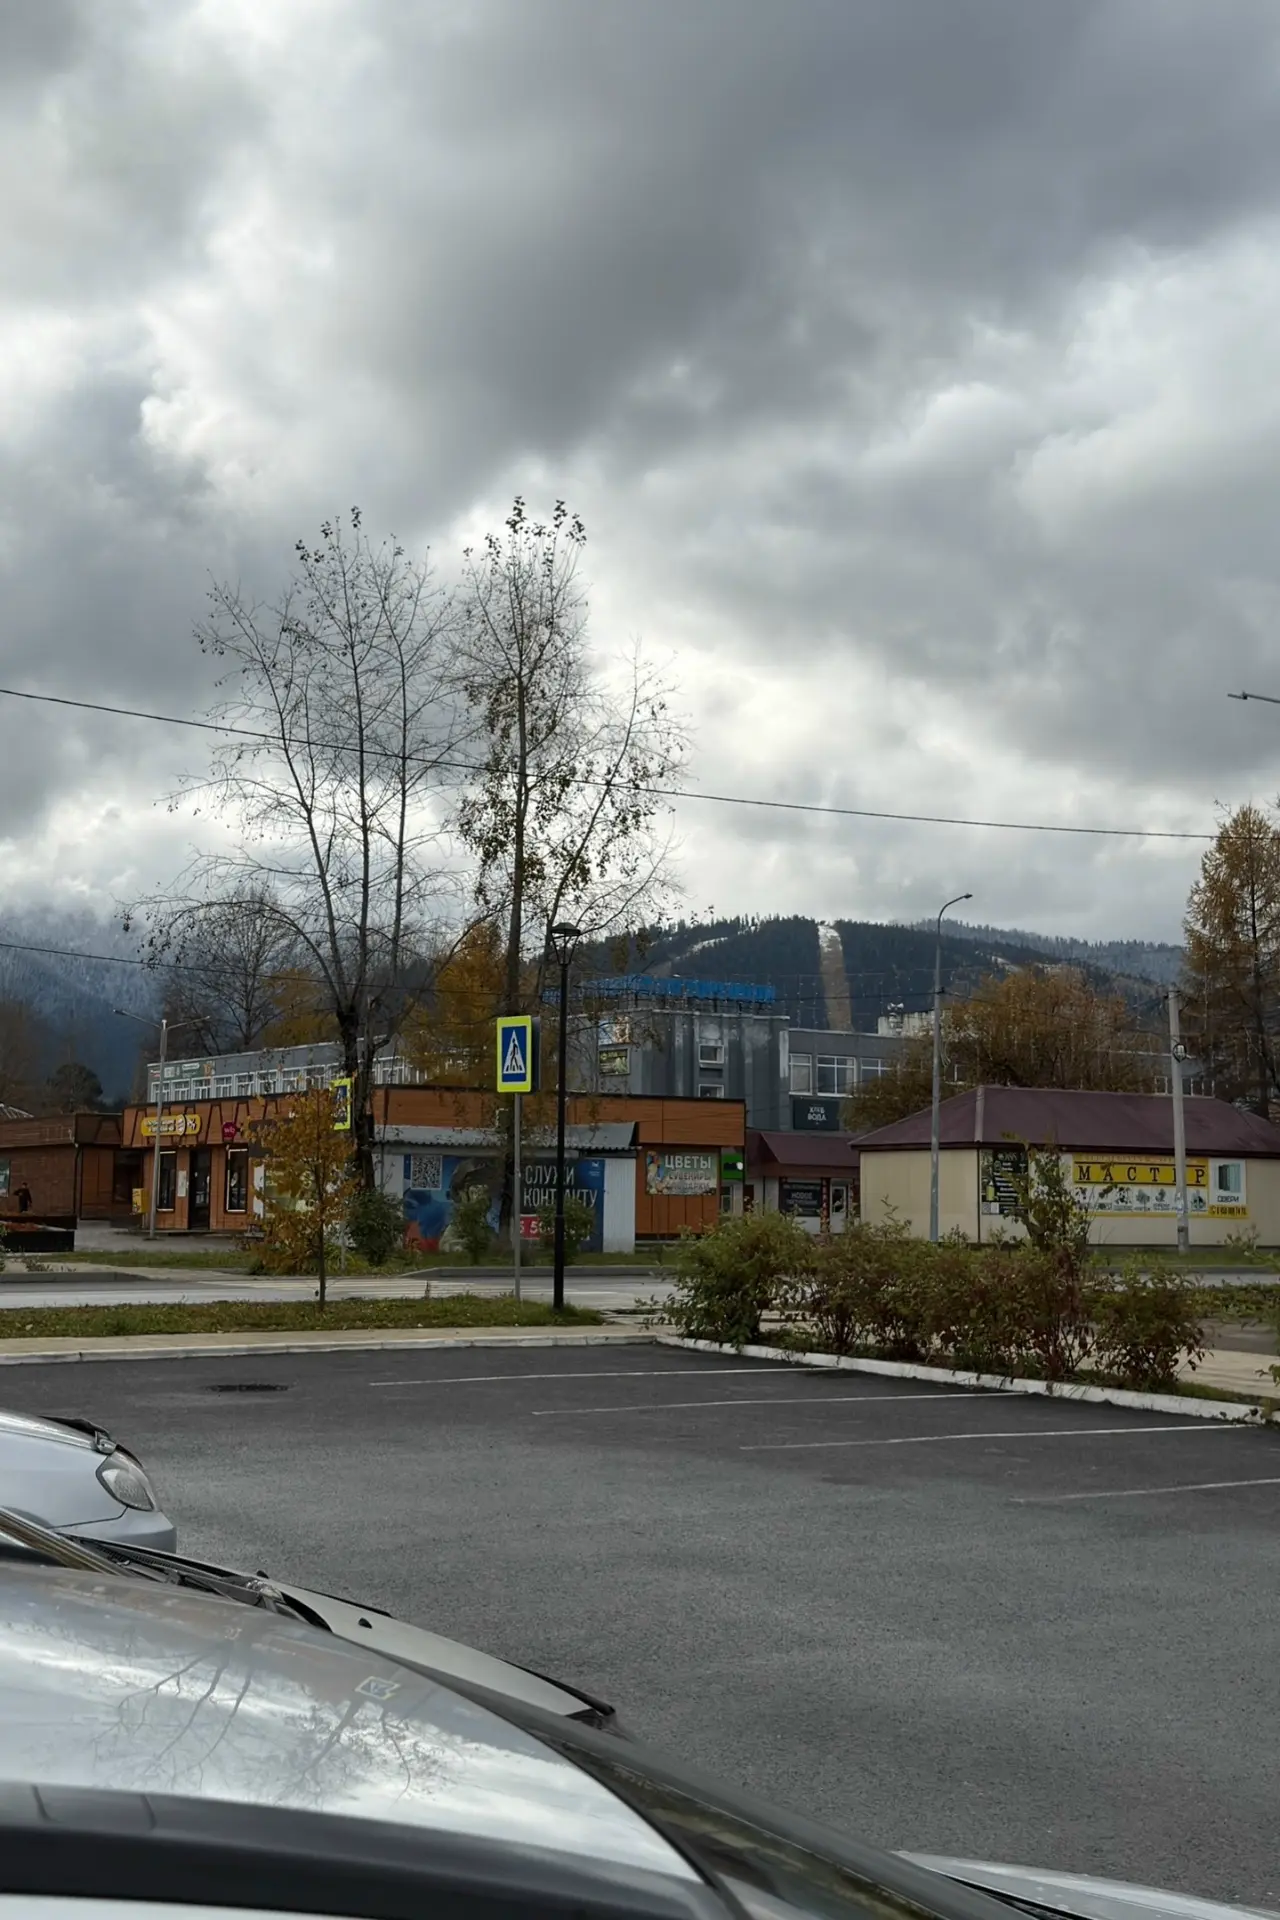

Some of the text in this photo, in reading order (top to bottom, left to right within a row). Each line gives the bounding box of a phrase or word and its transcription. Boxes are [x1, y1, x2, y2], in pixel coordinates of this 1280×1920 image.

[664, 1155, 711, 1170] ЦВЕТЫ
[1078, 1165, 1205, 1183] МАСТР
[523, 1188, 598, 1208] КОНТАКТУ
